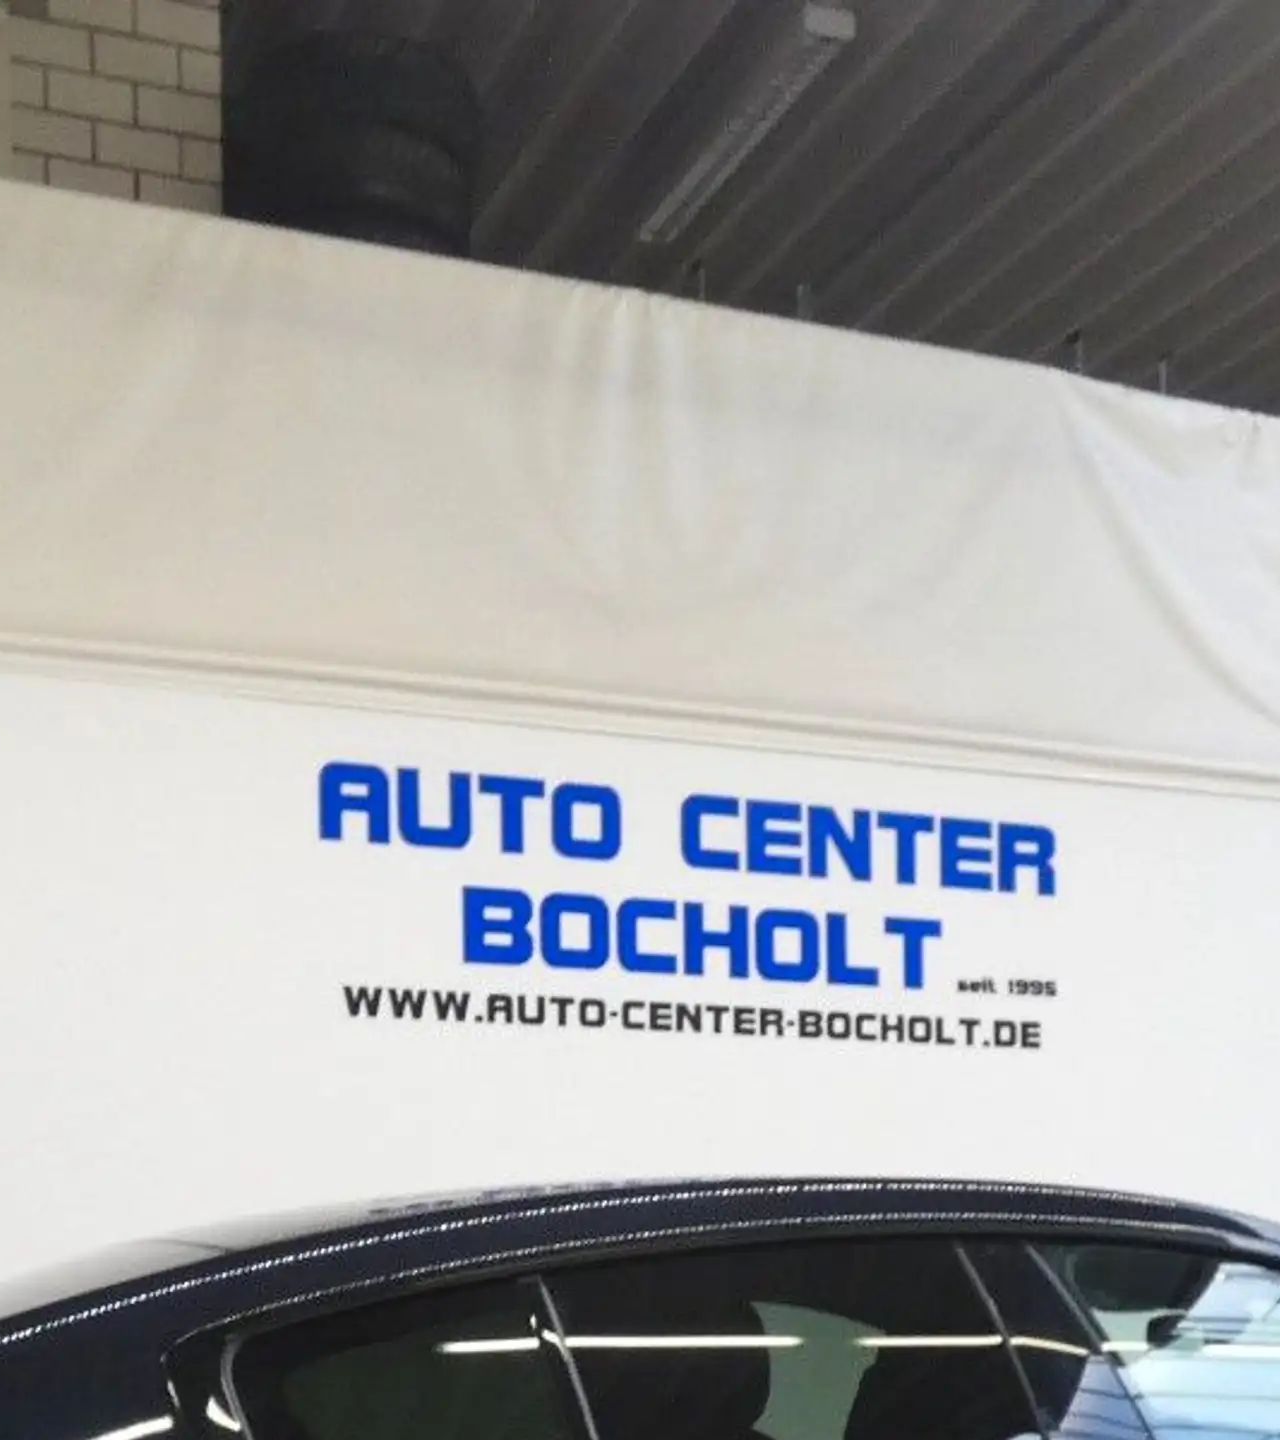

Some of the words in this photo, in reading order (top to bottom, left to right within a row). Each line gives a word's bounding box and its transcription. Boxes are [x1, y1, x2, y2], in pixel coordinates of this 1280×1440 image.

[318, 760, 624, 863] AUTO
[680, 793, 1058, 897] CENTER
[461, 884, 944, 991] BOCHOLT
[342, 984, 1042, 1050] WWW.AUTO-CENTER-BOCHOLT.DE
[956, 976, 997, 994] seit
[1007, 978, 1058, 997] 1995
